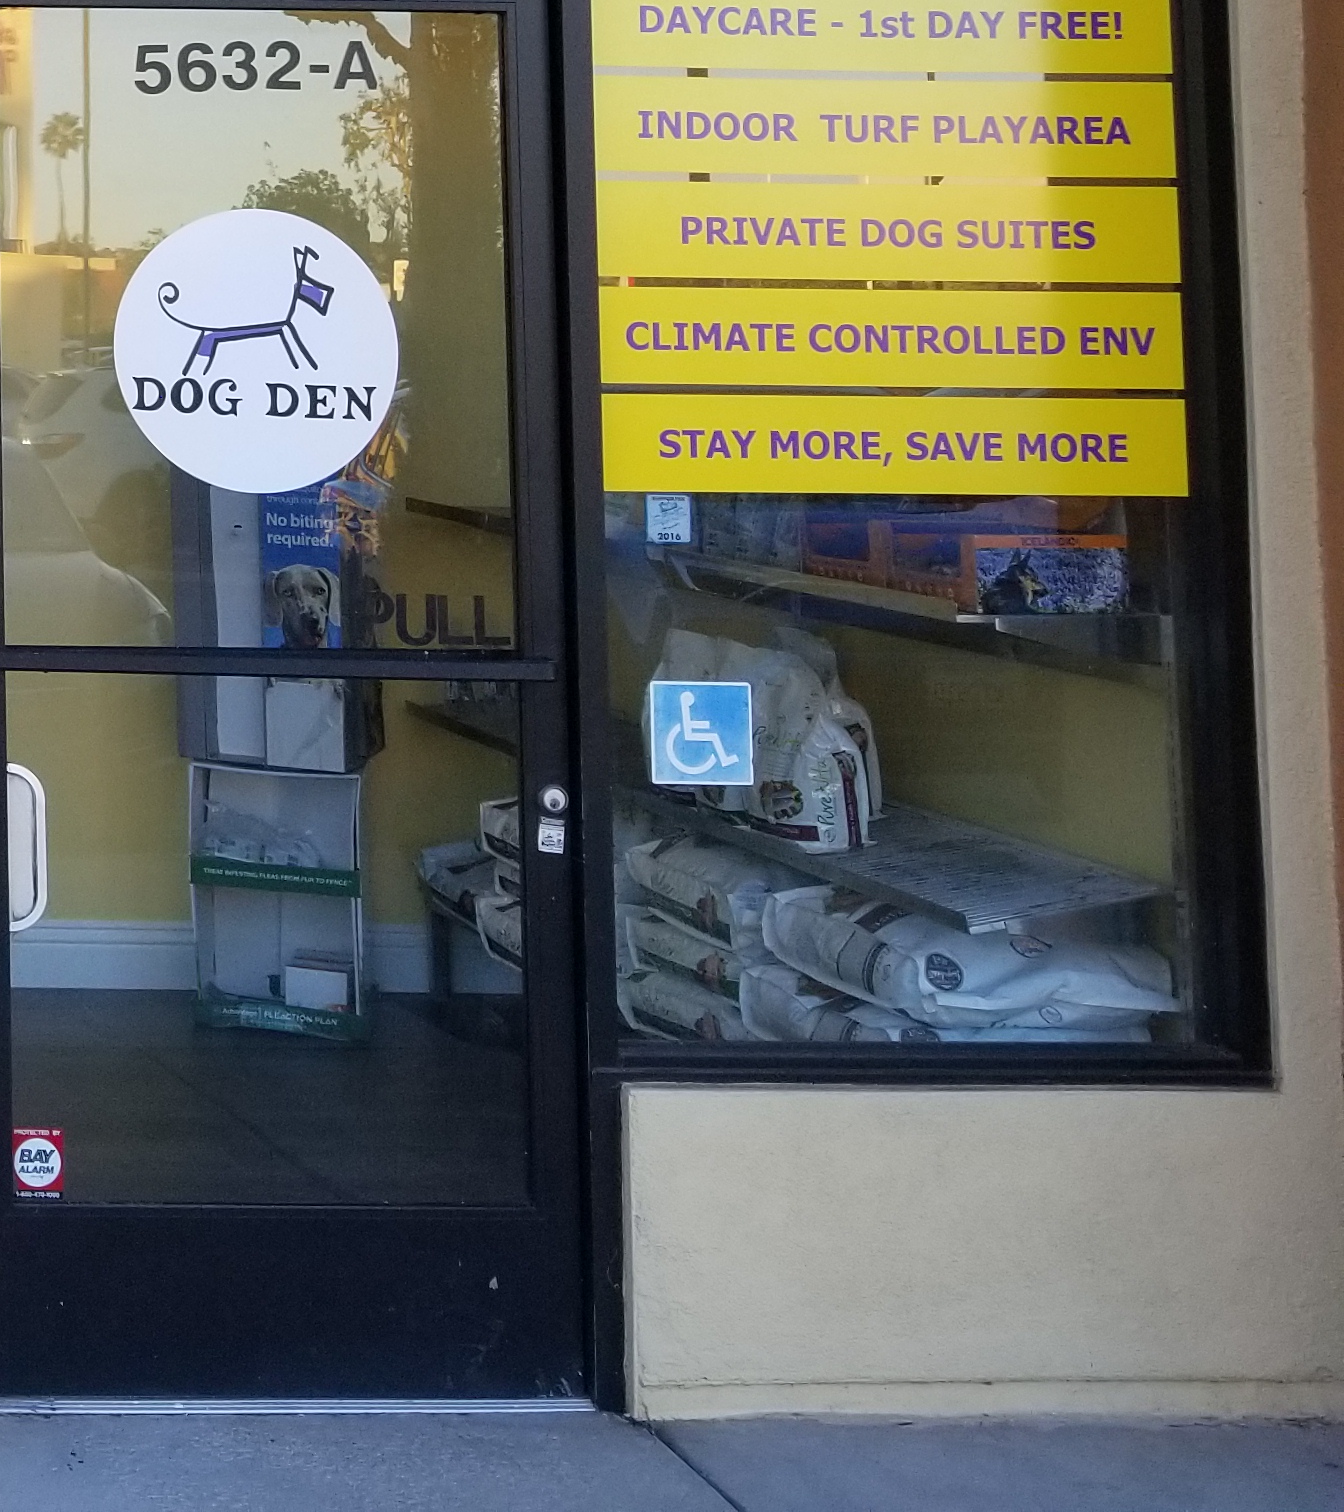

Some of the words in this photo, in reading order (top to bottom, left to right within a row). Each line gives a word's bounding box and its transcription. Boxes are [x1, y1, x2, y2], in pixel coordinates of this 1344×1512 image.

[639, 5, 817, 37] DAYCARE
[859, 9, 915, 39] 1st
[928, 10, 1004, 39] DAY
[1018, 11, 1124, 39] FREE!
[134, 41, 378, 95] 5632-A
[638, 110, 797, 141] INDOOR
[820, 114, 919, 143] TURF
[933, 115, 1131, 145] PLAYAREA
[681, 216, 846, 247] PRIVATE
[861, 219, 942, 248] DOG
[957, 220, 1096, 250] SUITES
[626, 321, 795, 352] CLIMATE
[809, 323, 1066, 355] CONTROLLED
[1080, 327, 1156, 355] ENV
[132, 375, 243, 417] DOG
[265, 382, 377, 422] DEN
[659, 429, 755, 459] STAY
[770, 430, 892, 466] MORE,
[906, 431, 1003, 461] SAVE
[1018, 433, 1128, 463] MORE
[265, 512, 288, 527] No
[290, 513, 334, 533] biting
[657, 531, 681, 541] 2016
[266, 532, 334, 549] required.
[368, 590, 511, 646] PULL
[18, 1148, 56, 1164] BAY
[18, 1165, 55, 1175] ALARM
